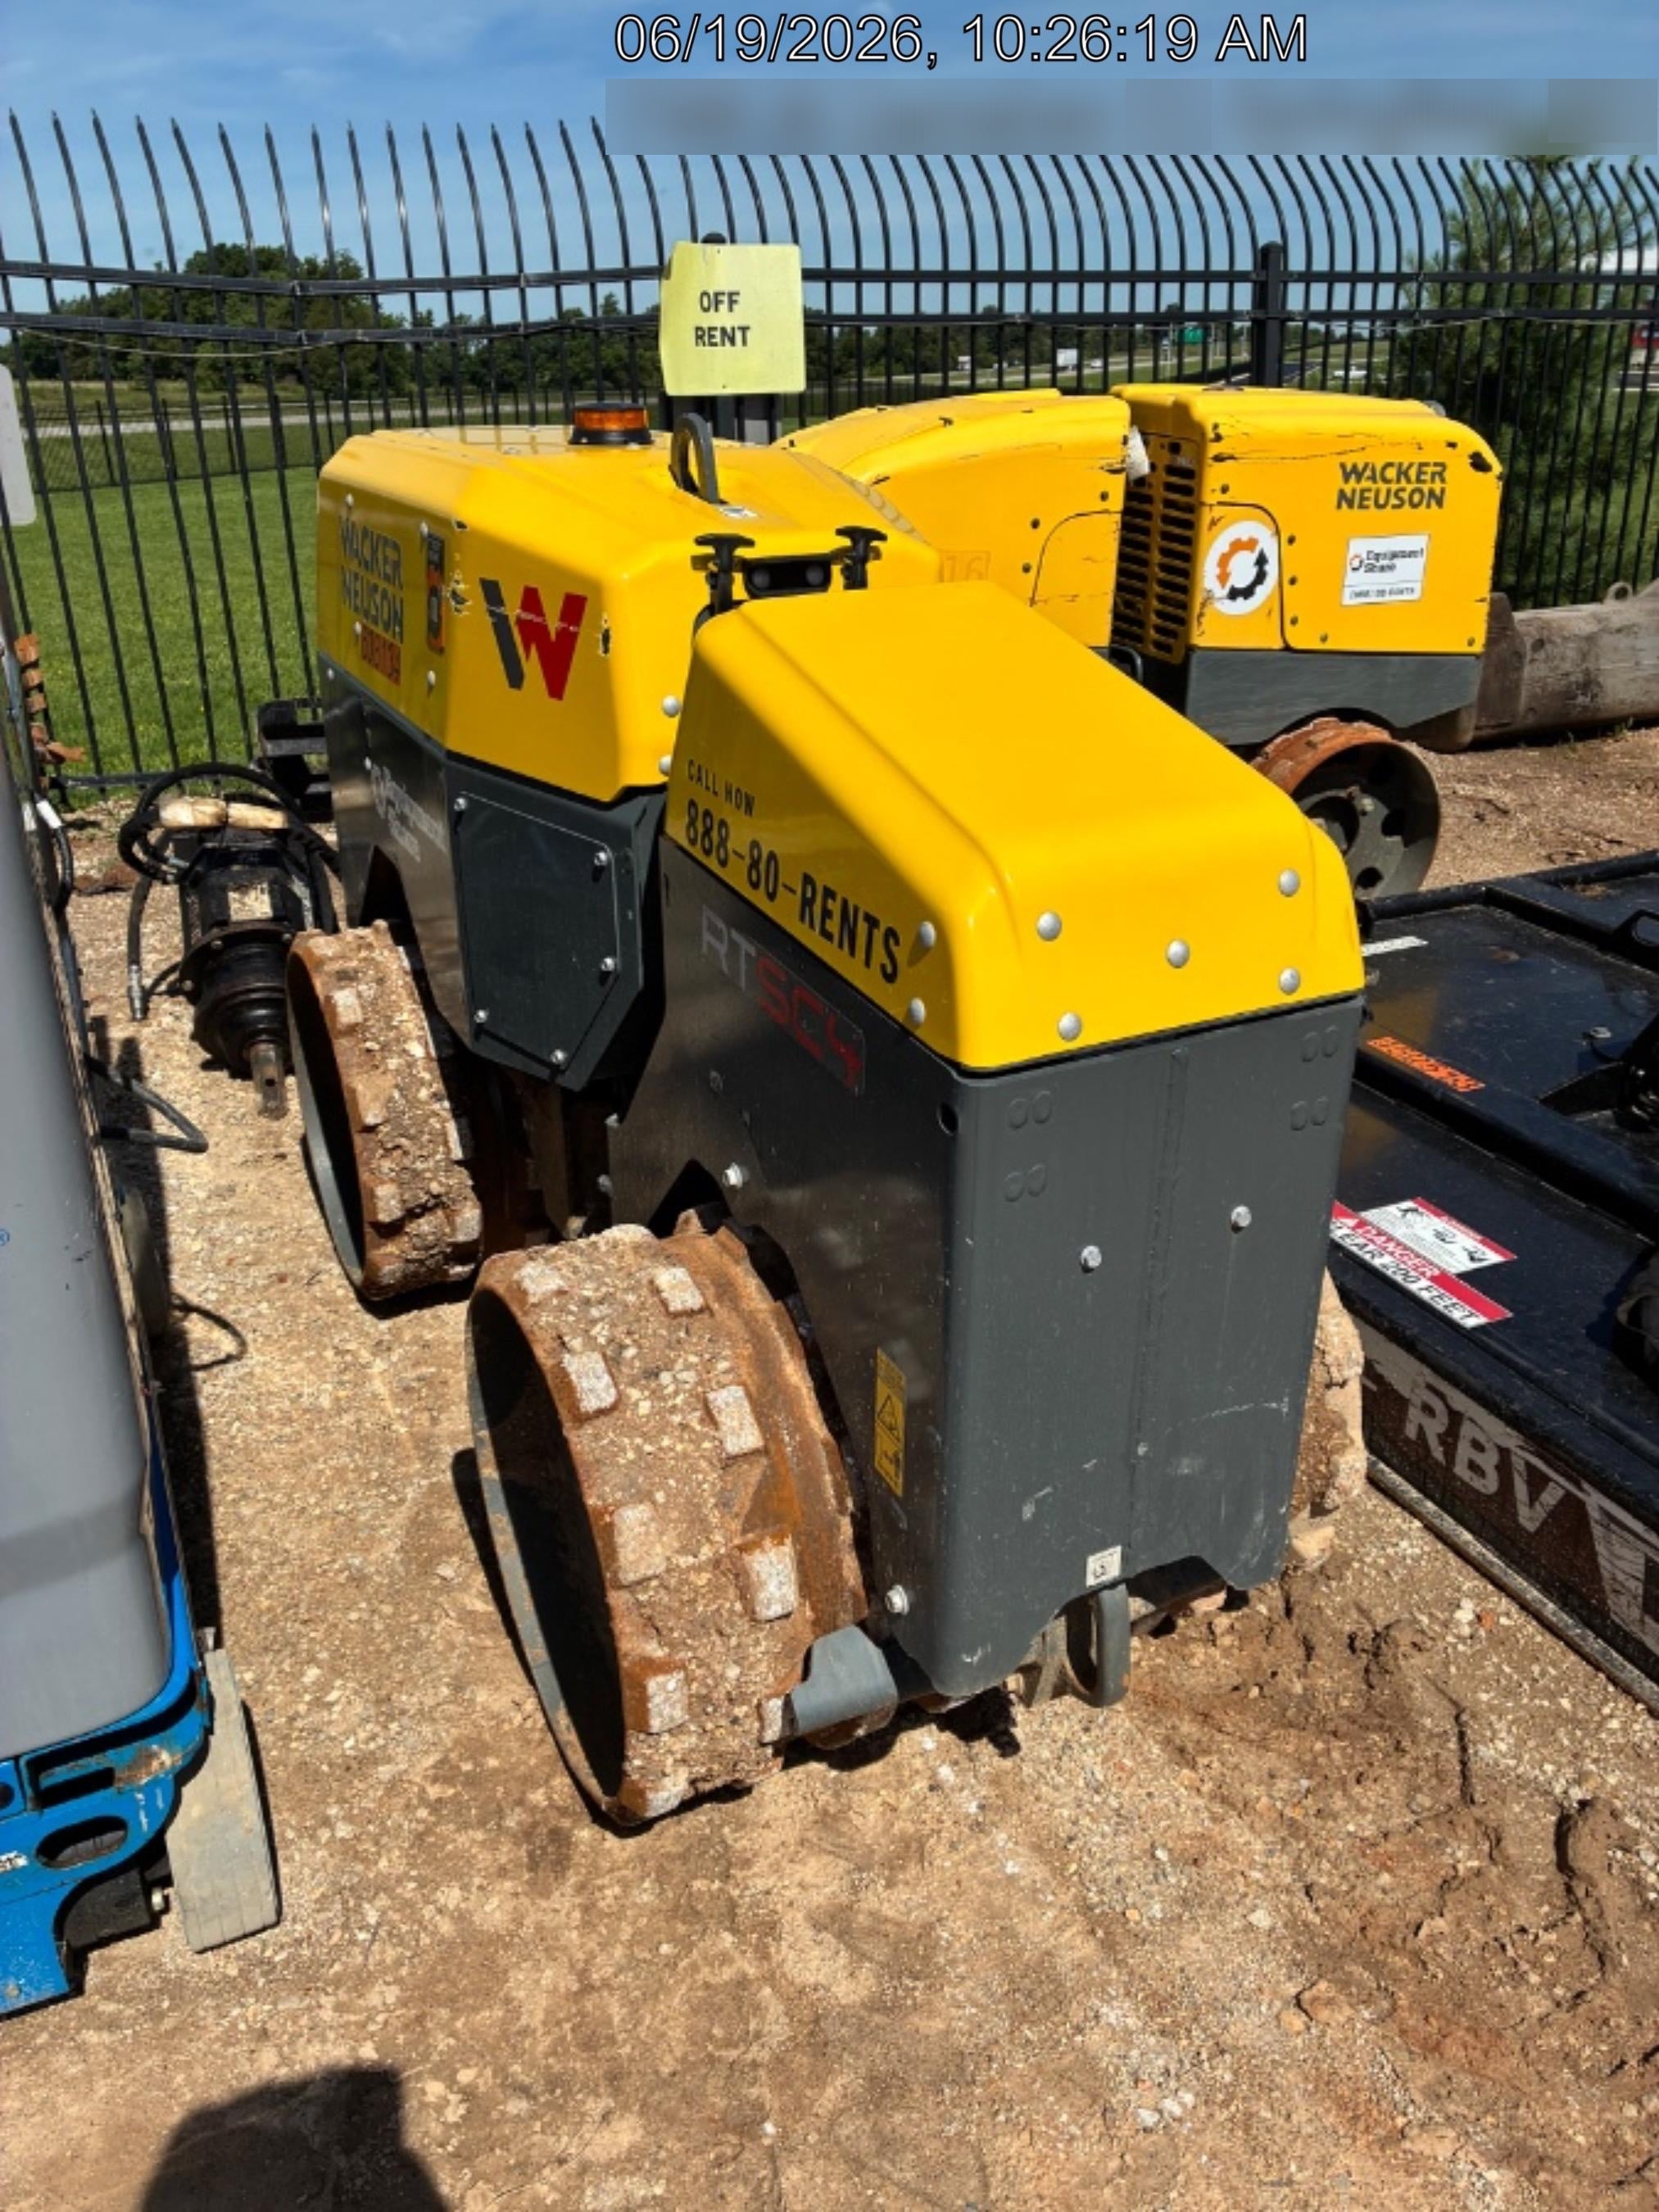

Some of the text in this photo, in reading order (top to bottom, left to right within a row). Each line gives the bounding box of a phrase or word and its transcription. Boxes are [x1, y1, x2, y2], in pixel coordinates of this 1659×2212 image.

[699, 290, 741, 315] OFF
[694, 324, 750, 349] RENT
[1338, 461, 1448, 485] WACKER
[1335, 487, 1446, 510] NEUSON
[687, 759, 718, 798] CALL
[684, 798, 902, 985] 888-80-RENTS
[1417, 1282, 1480, 1323] FEET
